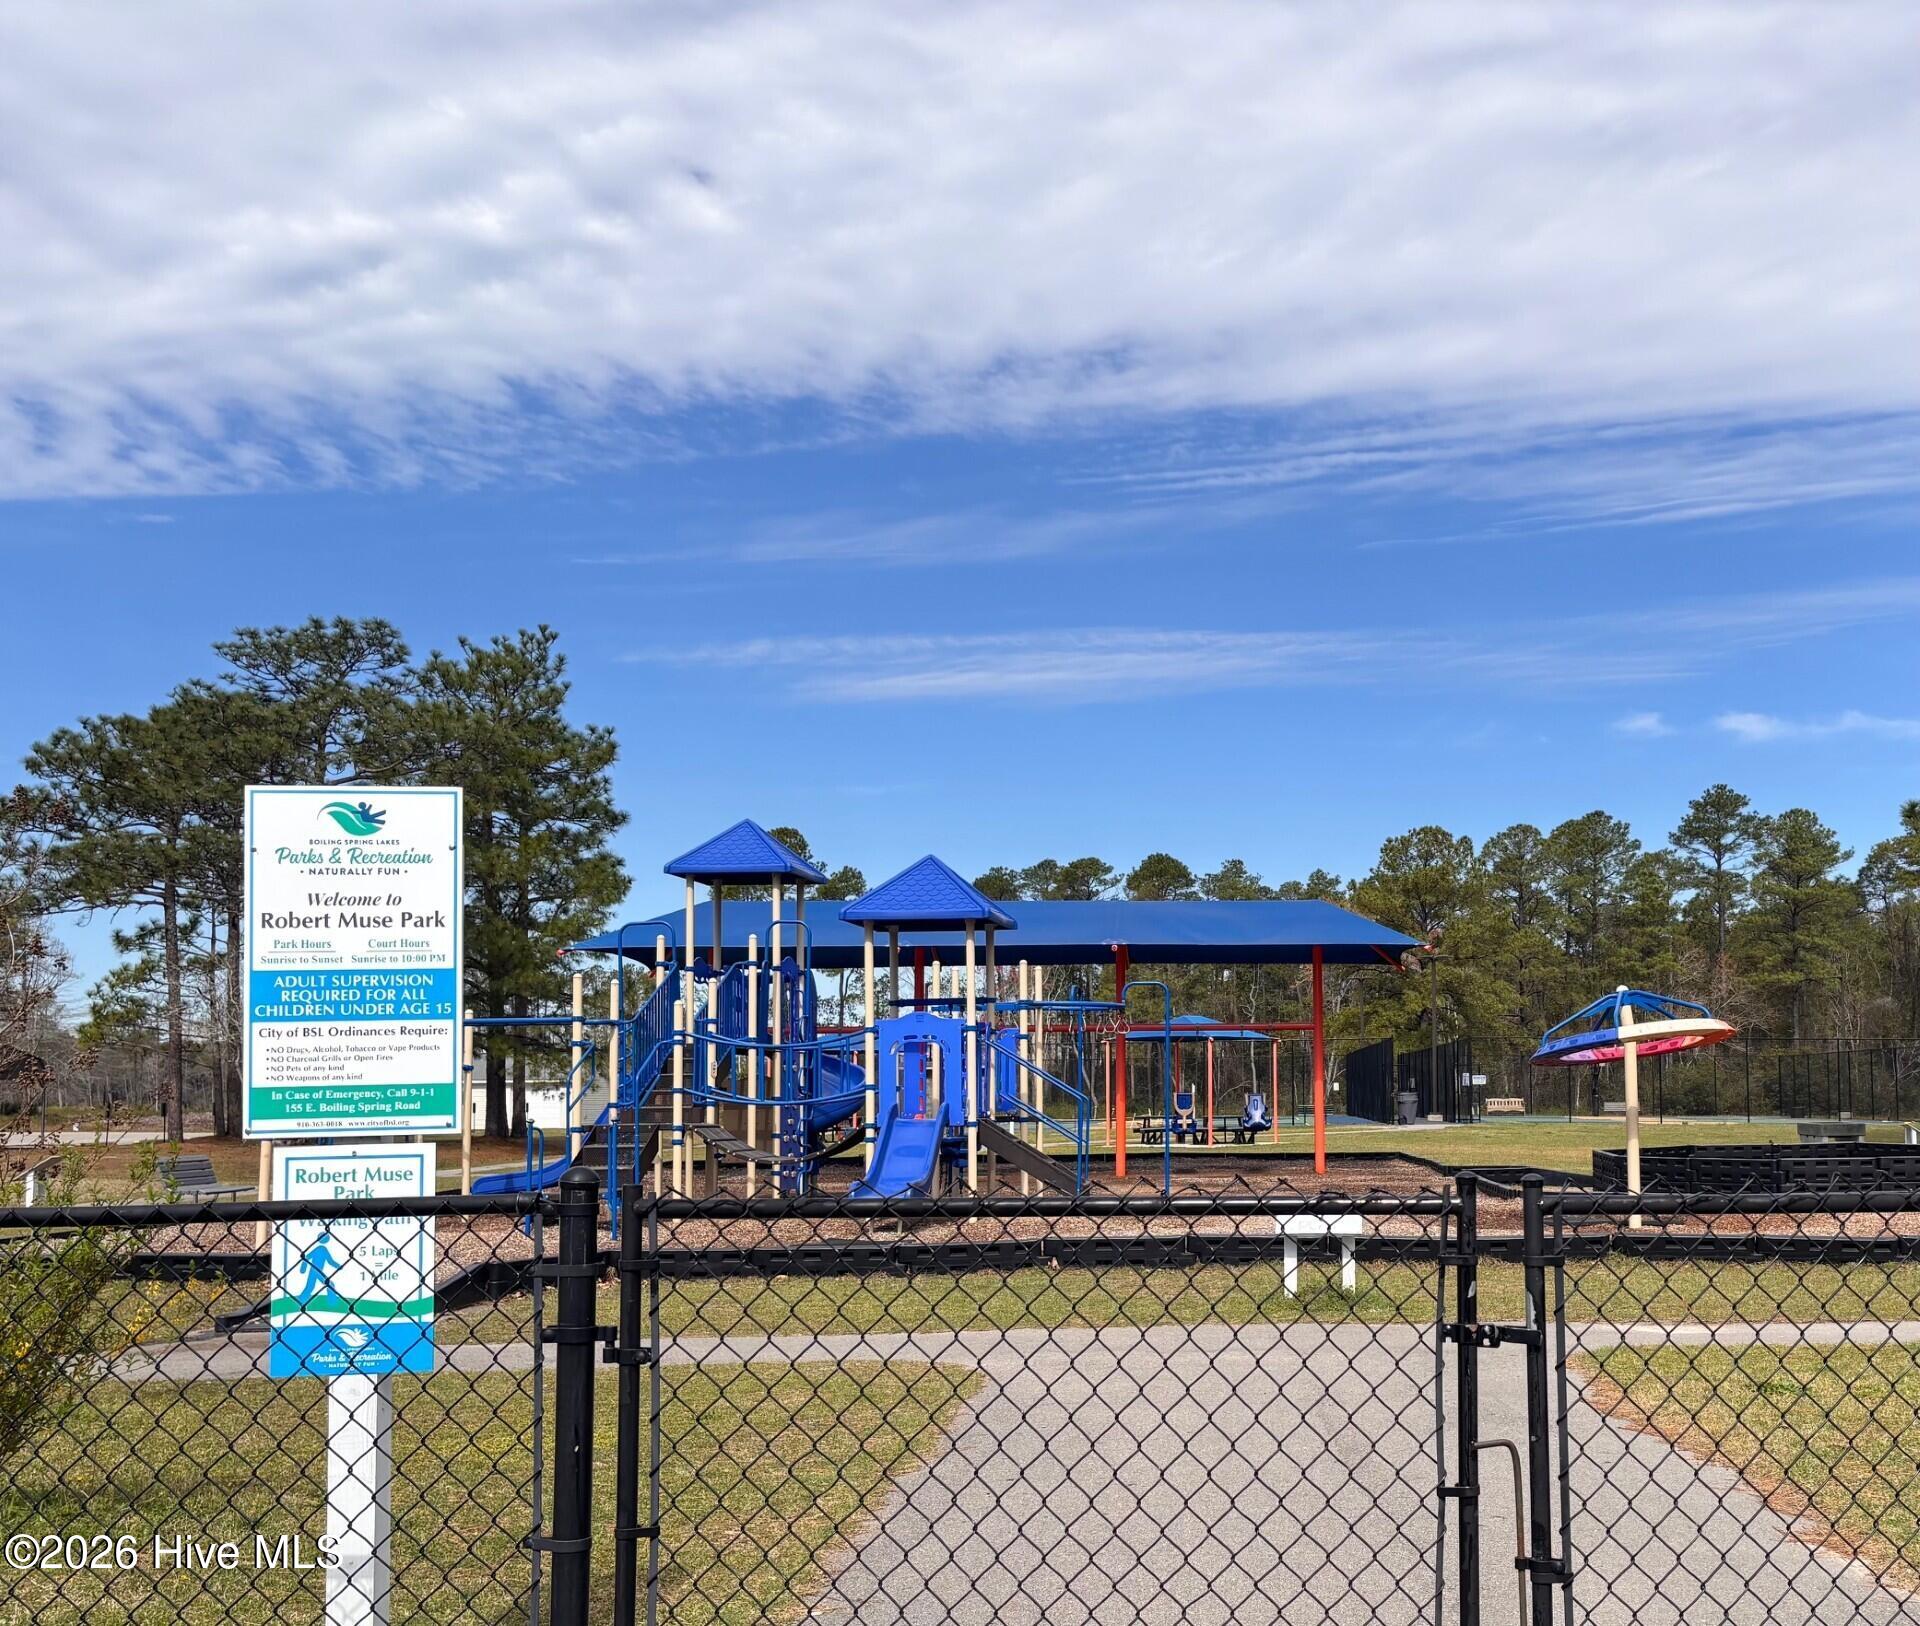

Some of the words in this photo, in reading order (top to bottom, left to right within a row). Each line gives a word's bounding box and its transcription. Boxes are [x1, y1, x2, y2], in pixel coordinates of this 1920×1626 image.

[275, 846, 324, 864] Parks
[328, 847, 342, 864] &
[347, 846, 433, 864] Recreation
[308, 868, 373, 876] NATURALLY
[378, 868, 400, 876] FUN
[308, 892, 382, 906] Welcome
[386, 893, 402, 906] to
[261, 911, 330, 929] Robert
[338, 912, 393, 928] Muse
[401, 910, 446, 928] Park
[273, 939, 298, 949] Park
[300, 939, 332, 948] Hours
[368, 938, 397, 948] Court
[400, 938, 430, 948] Hours
[260, 956, 297, 964] Sunrise
[300, 956, 309, 964] to
[312, 955, 343, 964] Sunset
[351, 955, 387, 964] Sunrise
[389, 955, 398, 963] to
[401, 954, 427, 963] 10:00
[430, 954, 446, 962] PM
[274, 975, 325, 988] ADULT
[332, 974, 434, 987] SUPERVISION
[281, 989, 361, 1003] REQUIRED
[366, 989, 396, 1001] FOR
[401, 988, 427, 1000] ALL
[254, 1004, 334, 1017] CHILDREN
[340, 1003, 395, 1016] UNDER
[400, 1003, 430, 1015] AGE
[436, 1002, 452, 1014] 15
[259, 1027, 283, 1040] City
[286, 1027, 299, 1038] of
[303, 1027, 324, 1037] BSL
[328, 1026, 396, 1037] Ordinances
[400, 1026, 448, 1038] Require:
[272, 1091, 282, 1100] In
[285, 1091, 310, 1099] Case
[312, 1090, 323, 1099] of
[325, 1090, 384, 1100] Emergency,
[387, 1088, 408, 1097] Call
[410, 1088, 434, 1096] 9-1-1
[285, 1103, 302, 1112] 155
[306, 1103, 316, 1112] E.
[320, 1102, 355, 1113] Boiling
[358, 1102, 392, 1113] Spring
[394, 1101, 421, 1110] Road
[295, 1167, 358, 1183] Robert
[364, 1167, 414, 1182] Muse
[334, 1184, 375, 1199] Park
[359, 1246, 366, 1256] 5
[360, 1272, 365, 1280] 1
[311, 1353, 336, 1362] Parks
[338, 1352, 346, 1362] &
